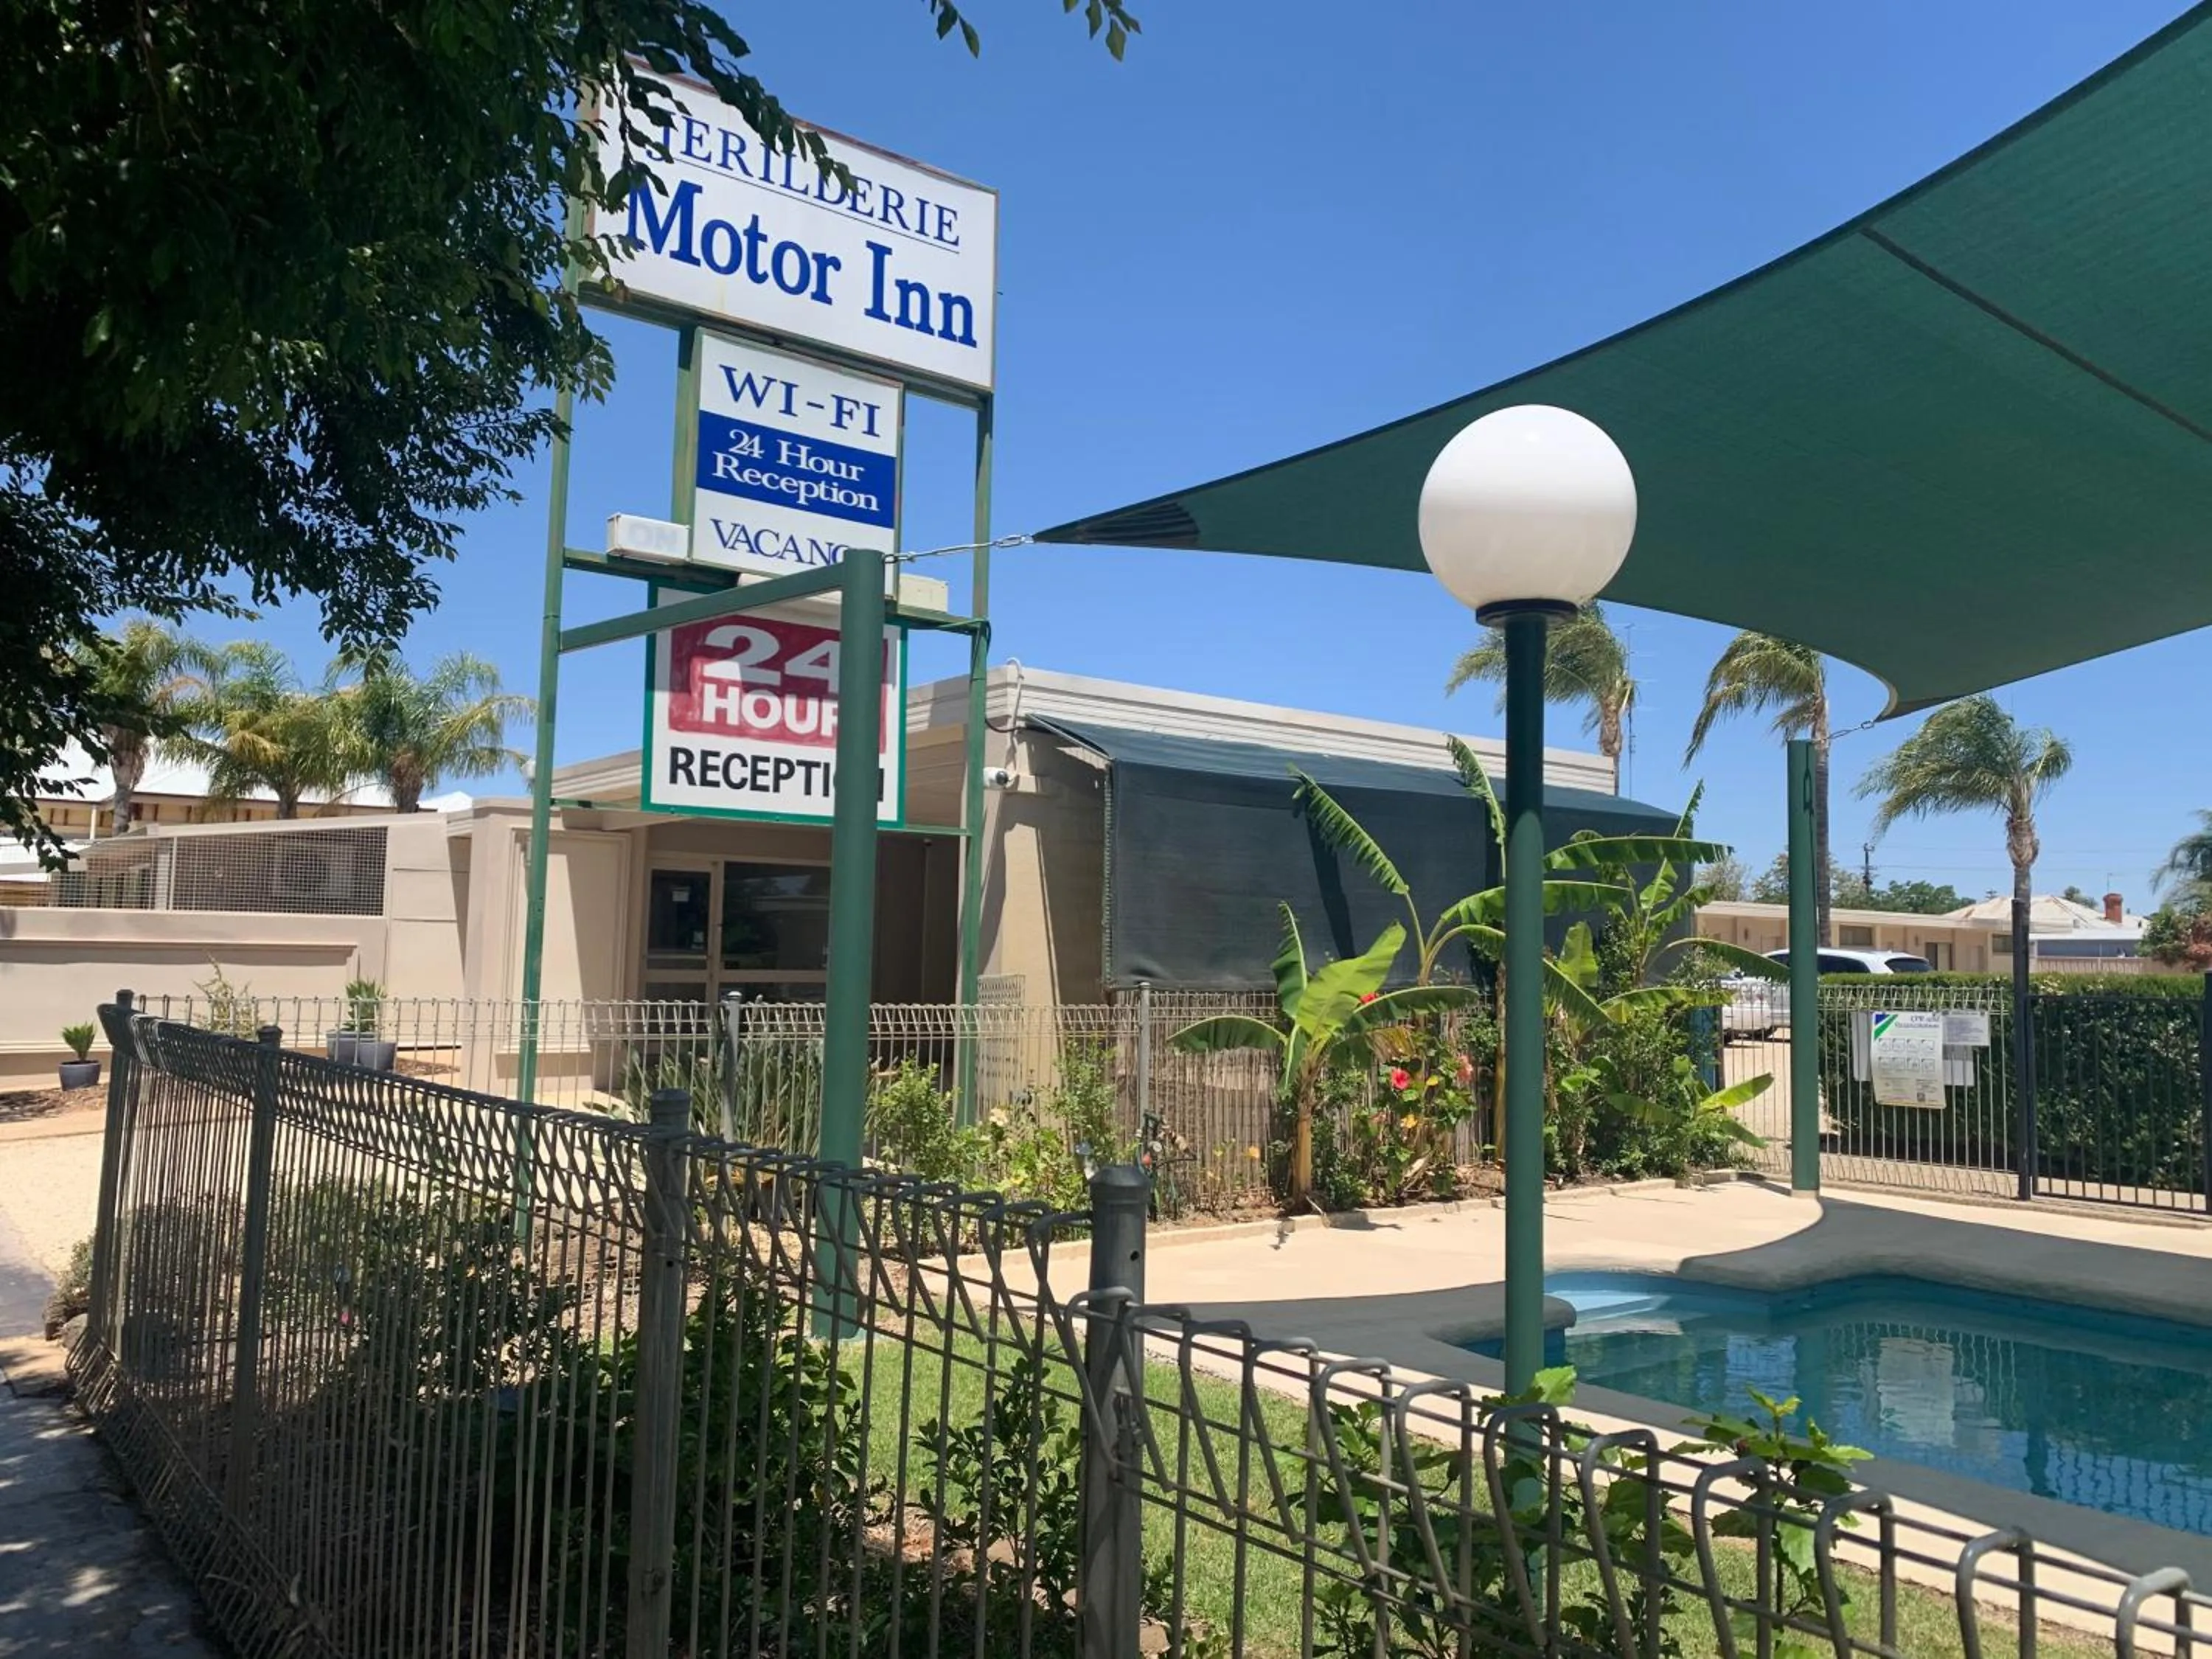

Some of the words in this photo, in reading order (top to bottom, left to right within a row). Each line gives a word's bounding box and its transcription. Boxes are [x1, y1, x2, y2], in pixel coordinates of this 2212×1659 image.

[646, 111, 960, 247] JERILDERIE
[626, 177, 842, 306] Motor
[864, 240, 978, 348] Inn
[719, 364, 881, 438] WI-FI
[712, 451, 880, 512] Reception
[729, 429, 765, 459] 24
[776, 439, 866, 482] Hour
[704, 625, 841, 694] 24
